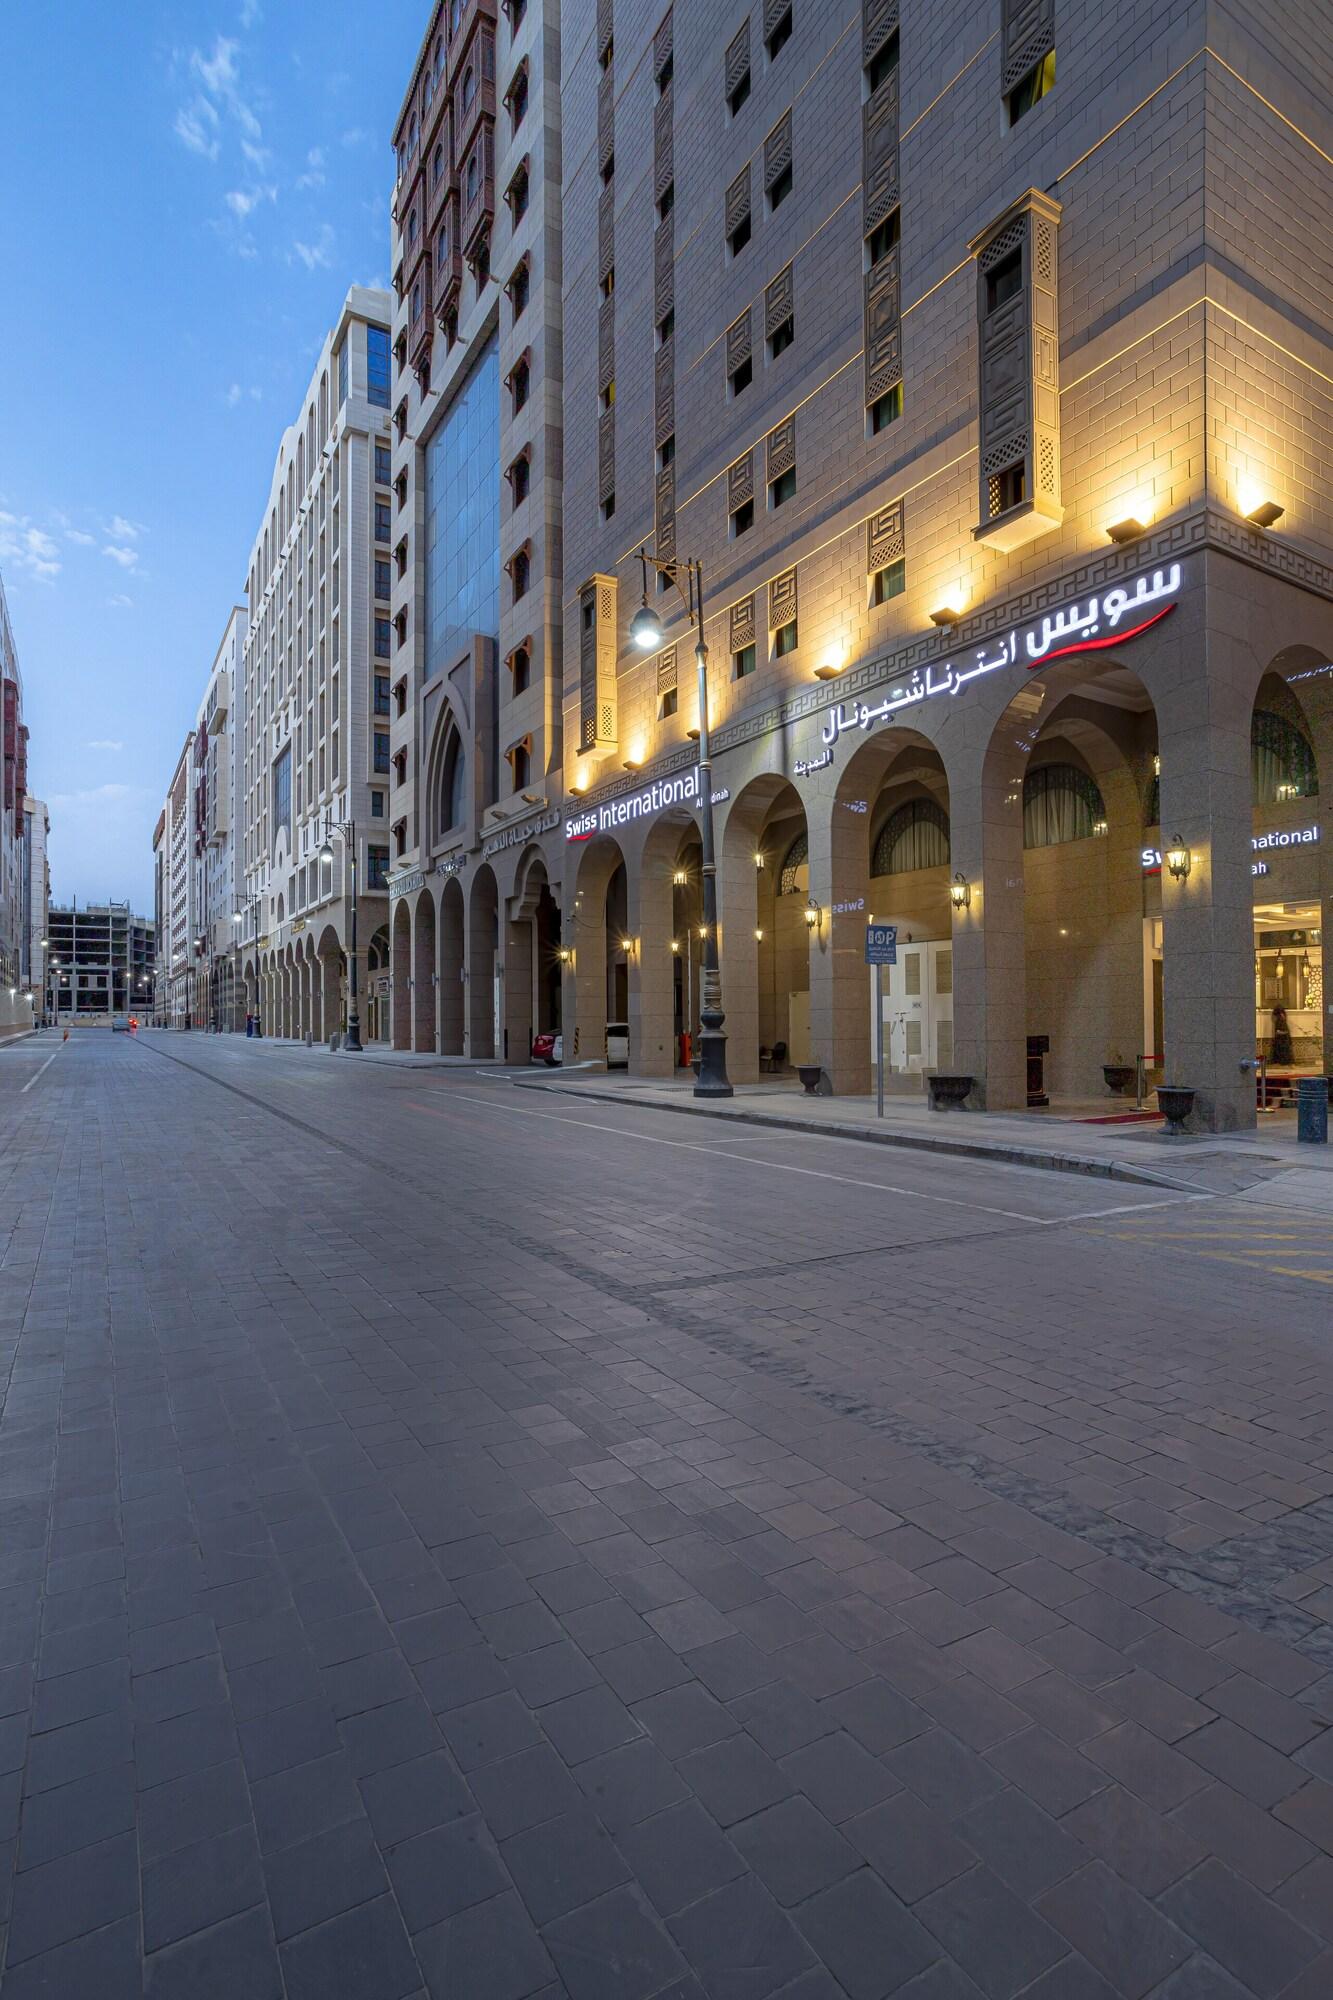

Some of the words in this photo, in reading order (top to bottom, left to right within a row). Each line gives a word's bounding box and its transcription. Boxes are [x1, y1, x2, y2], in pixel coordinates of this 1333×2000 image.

[1026, 564, 1181, 658] سويس
[793, 749, 830, 775] المدينة
[565, 813, 597, 838] Swiss
[599, 766, 699, 831] International
[1251, 826, 1318, 849] national
